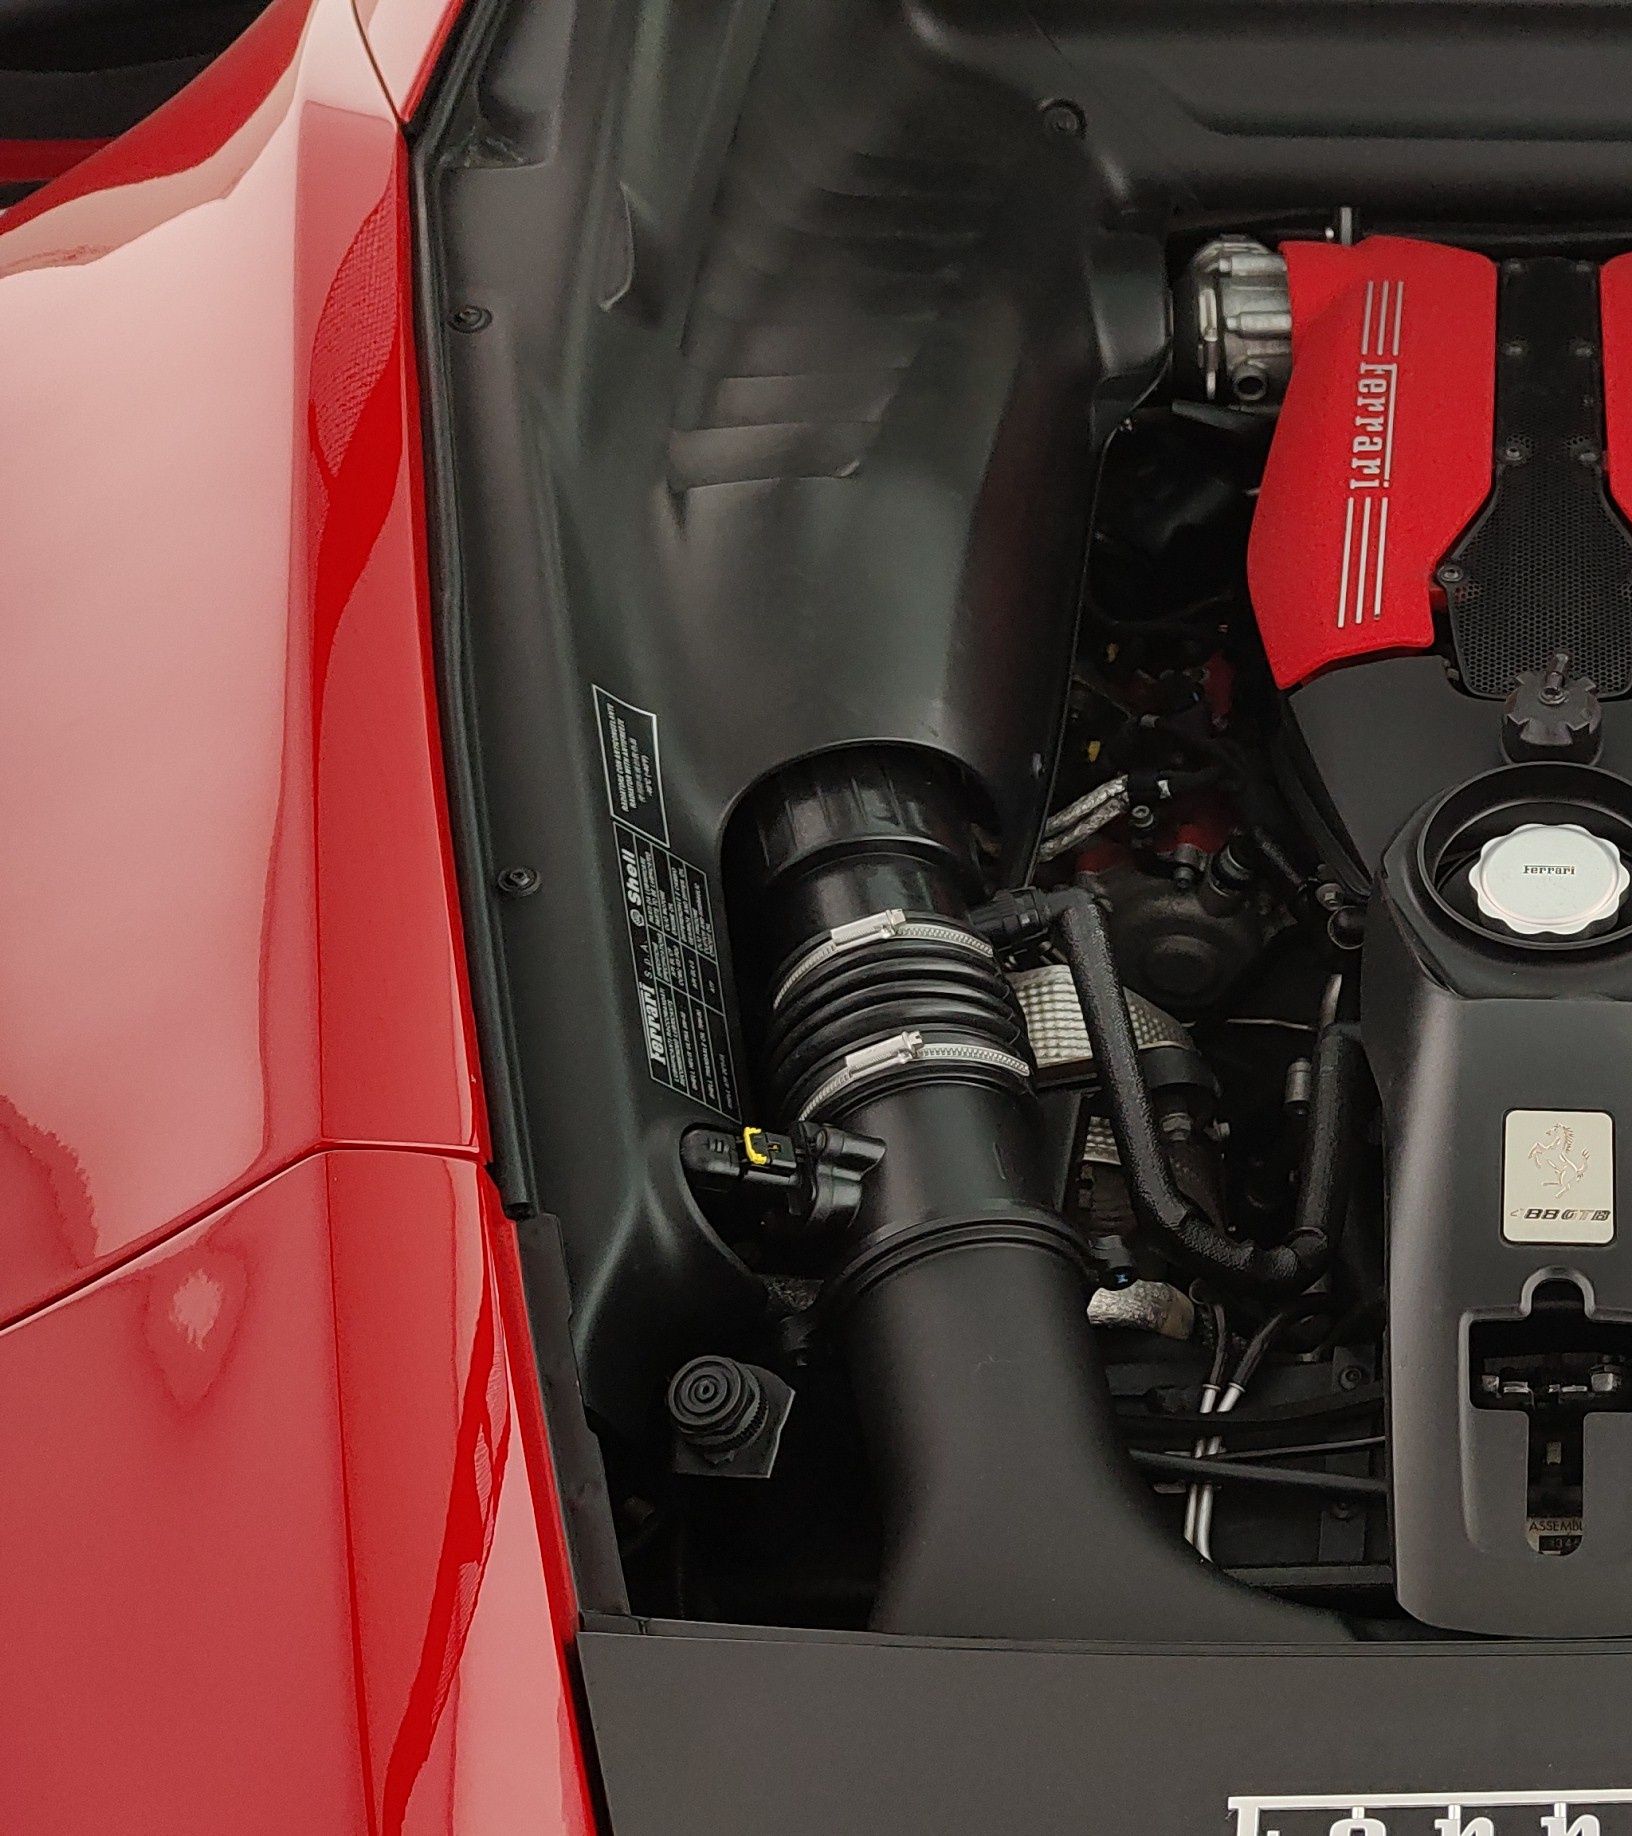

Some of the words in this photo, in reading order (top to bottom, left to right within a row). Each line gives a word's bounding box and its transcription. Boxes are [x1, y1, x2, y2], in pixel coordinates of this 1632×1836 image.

[1350, 363, 1397, 489] Ferrari
[621, 848, 643, 906] Shell
[1523, 865, 1575, 875] Ferrari
[639, 982, 666, 1065] Ferrari
